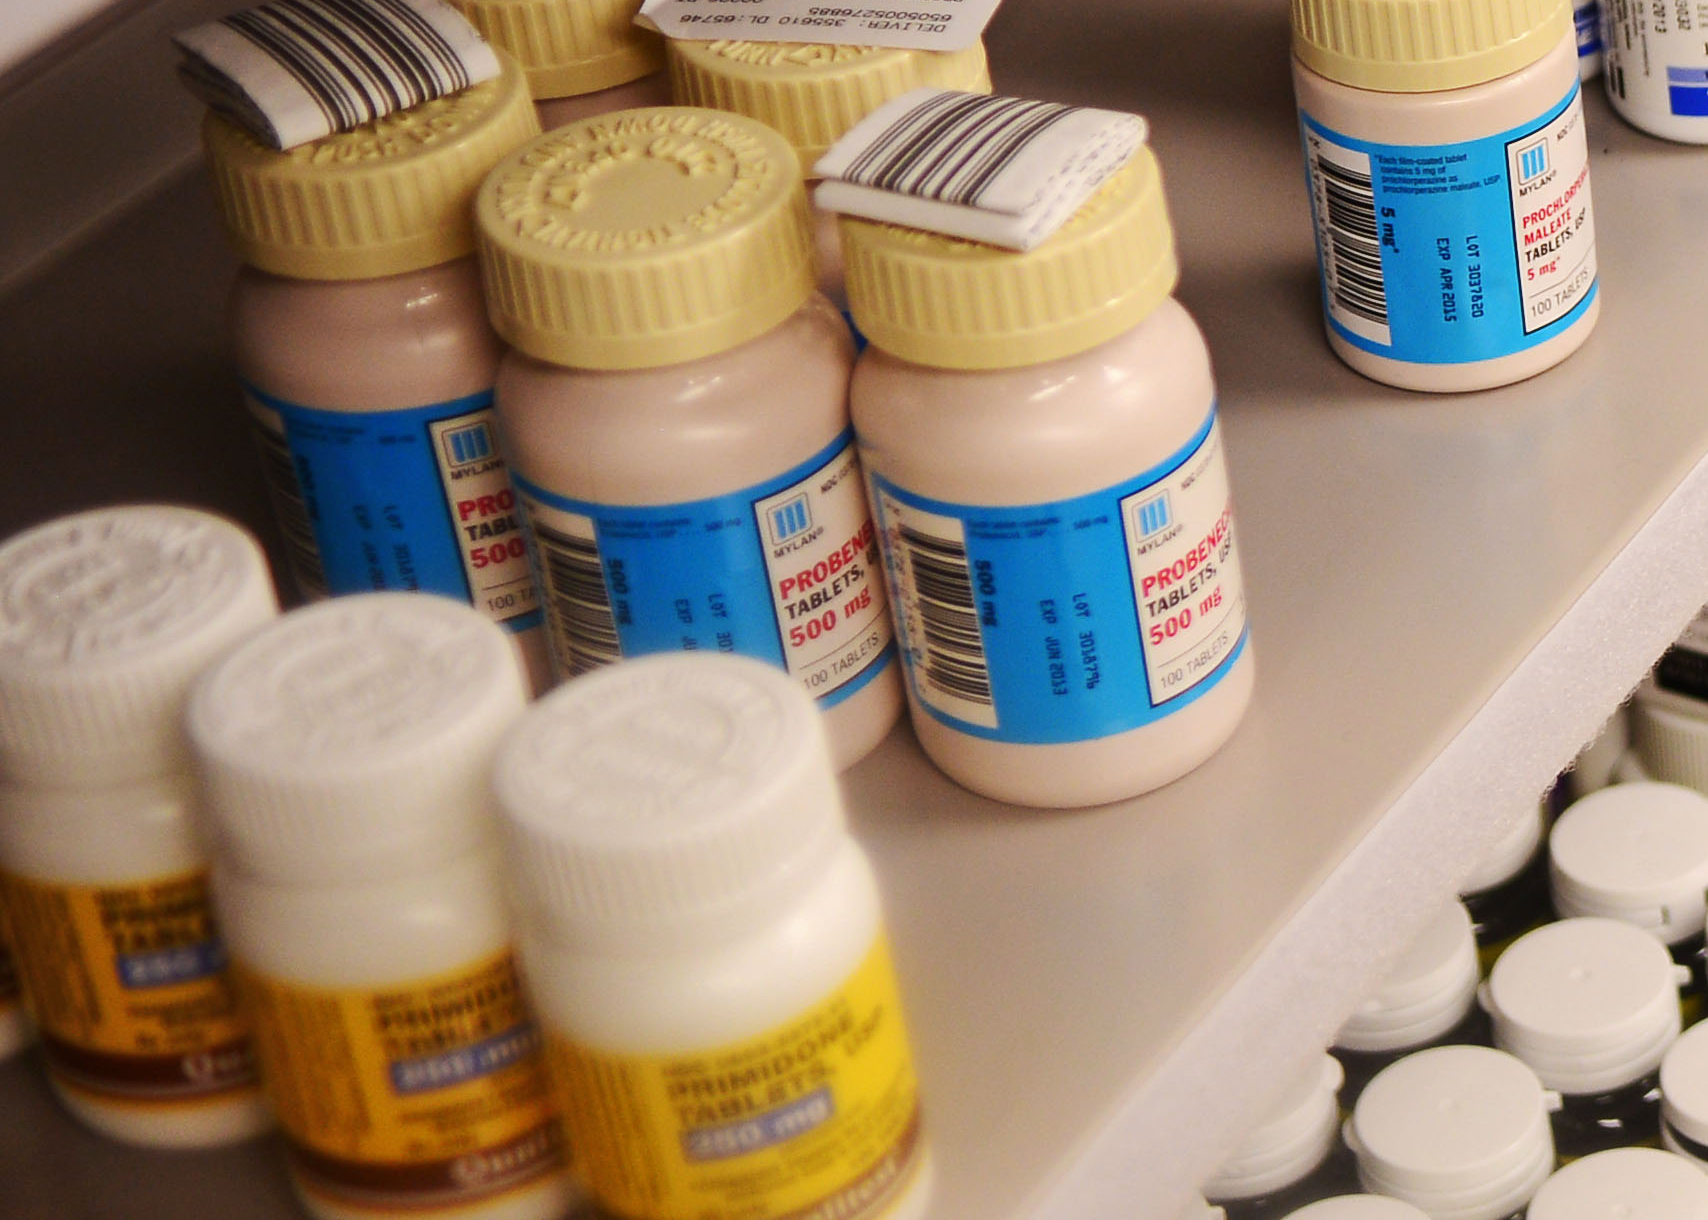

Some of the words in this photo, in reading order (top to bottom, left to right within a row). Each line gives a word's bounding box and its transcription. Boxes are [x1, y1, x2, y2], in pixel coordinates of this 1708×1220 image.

[778, 16, 846, 28] 355610
[808, 7, 952, 22] 6505005276885
[859, 16, 946, 34] DELIVER:
[1381, 206, 1396, 219] 5
[1523, 207, 1573, 247] MALEATE
[1436, 237, 1452, 262] EXP
[1465, 235, 1481, 258] LOT
[1440, 267, 1454, 291] APR
[1527, 266, 1535, 281] 5
[1531, 297, 1552, 318] 100
[1555, 266, 1589, 306] TABLETS
[457, 487, 516, 523] PRO
[464, 514, 519, 542] TABL
[469, 536, 526, 569] 500
[974, 559, 997, 596] 500
[1145, 560, 1217, 618] TABLETS,
[707, 592, 728, 618] LOT
[783, 563, 865, 620] TABLETS,
[1072, 592, 1091, 618] LOT
[674, 598, 694, 624] EXP
[788, 610, 837, 648] 500
[844, 584, 872, 620] mg
[1039, 598, 1058, 625] EXP
[1148, 607, 1192, 646] 500
[1199, 585, 1223, 617] mg
[802, 668, 829, 691] 100
[831, 631, 880, 678] TABLETS
[1044, 635, 1061, 660] JUN
[1160, 666, 1184, 689] 100
[1186, 630, 1230, 675] TABLETS
[1049, 663, 1069, 697] 2013
